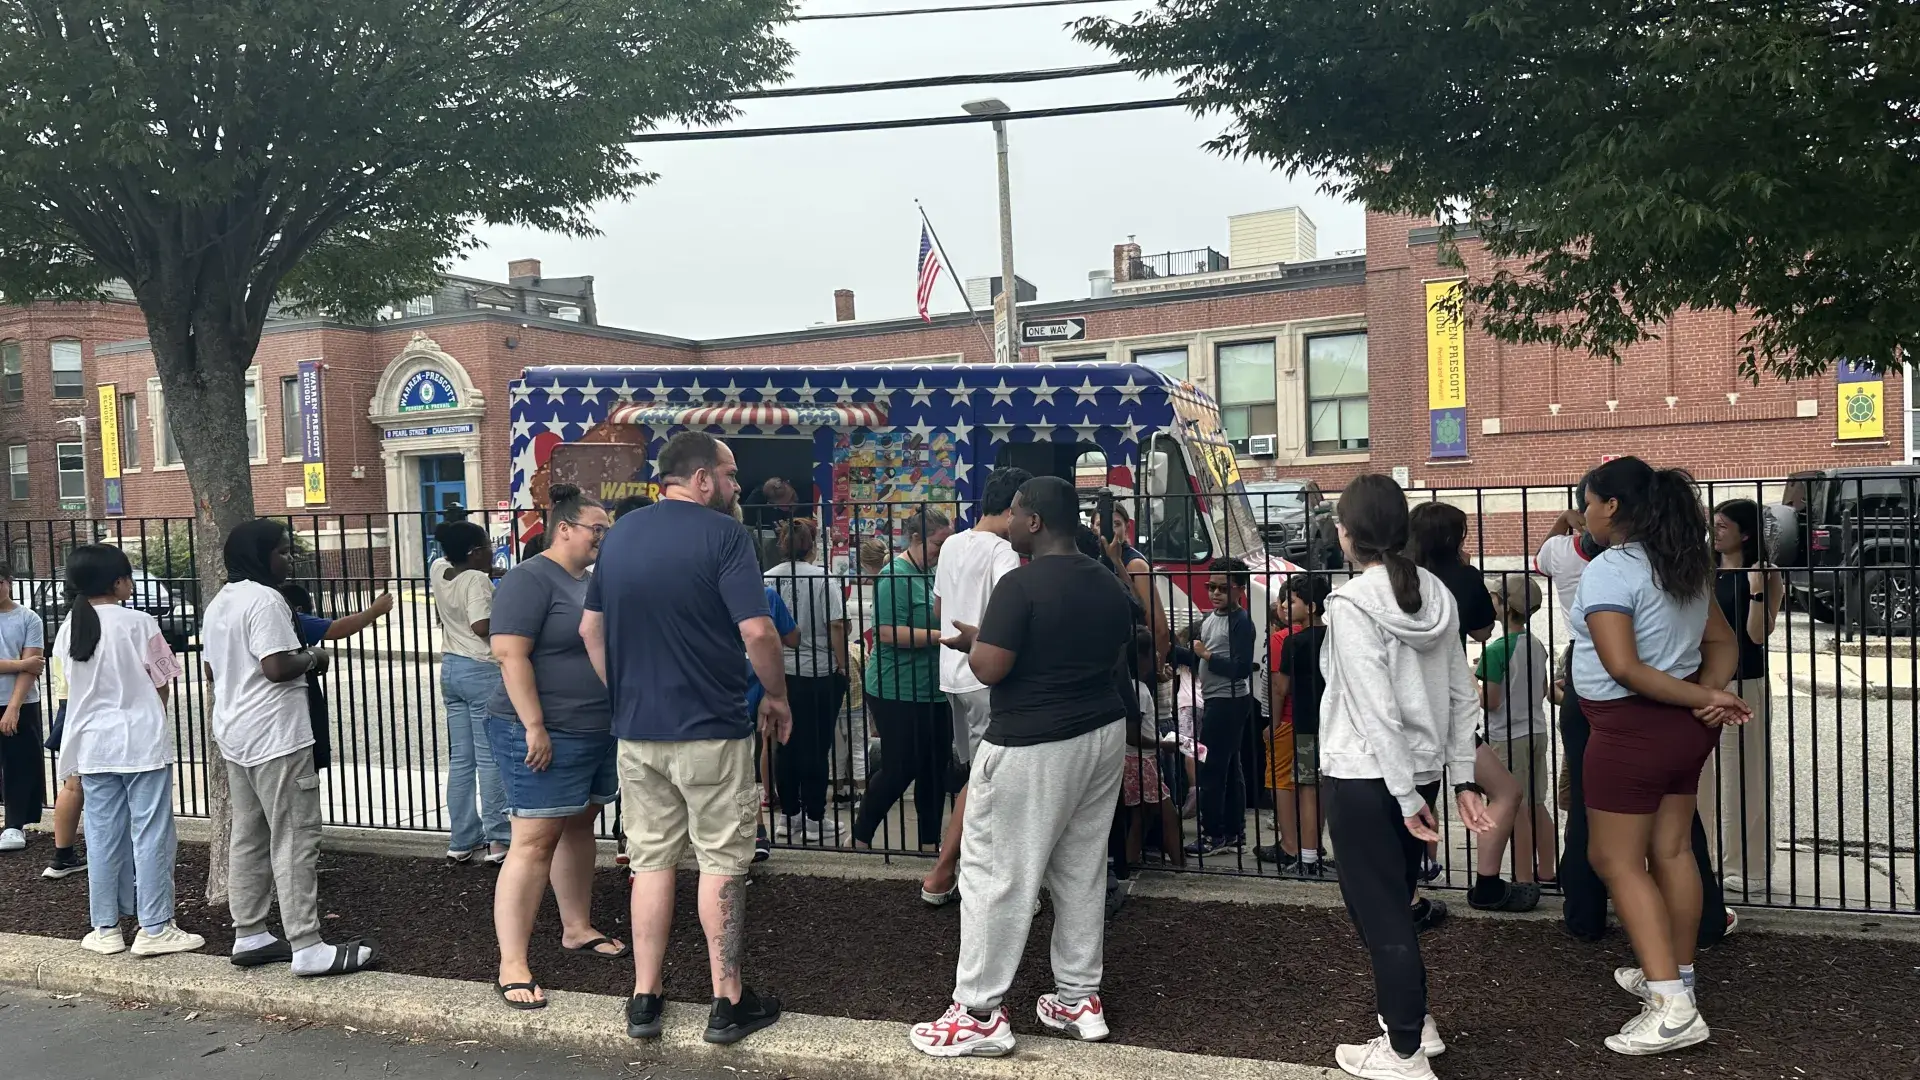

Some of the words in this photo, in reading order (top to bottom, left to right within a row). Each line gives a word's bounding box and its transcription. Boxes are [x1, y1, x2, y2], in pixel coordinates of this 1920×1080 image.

[1028, 327, 1046, 336] ONE
[1050, 326, 1067, 335] WAY
[1436, 294, 1445, 336] SHOOL
[1448, 293, 1460, 400] EN-PRESCOTT
[400, 371, 456, 406] WARREN-PRESCOTT
[310, 371, 320, 458] WARREN-PRESCOTT
[392, 429, 408, 438] PEARL
[409, 428, 428, 437] STREET
[432, 425, 470, 435] CHARLESTOWN
[600, 481, 660, 503] WATER
